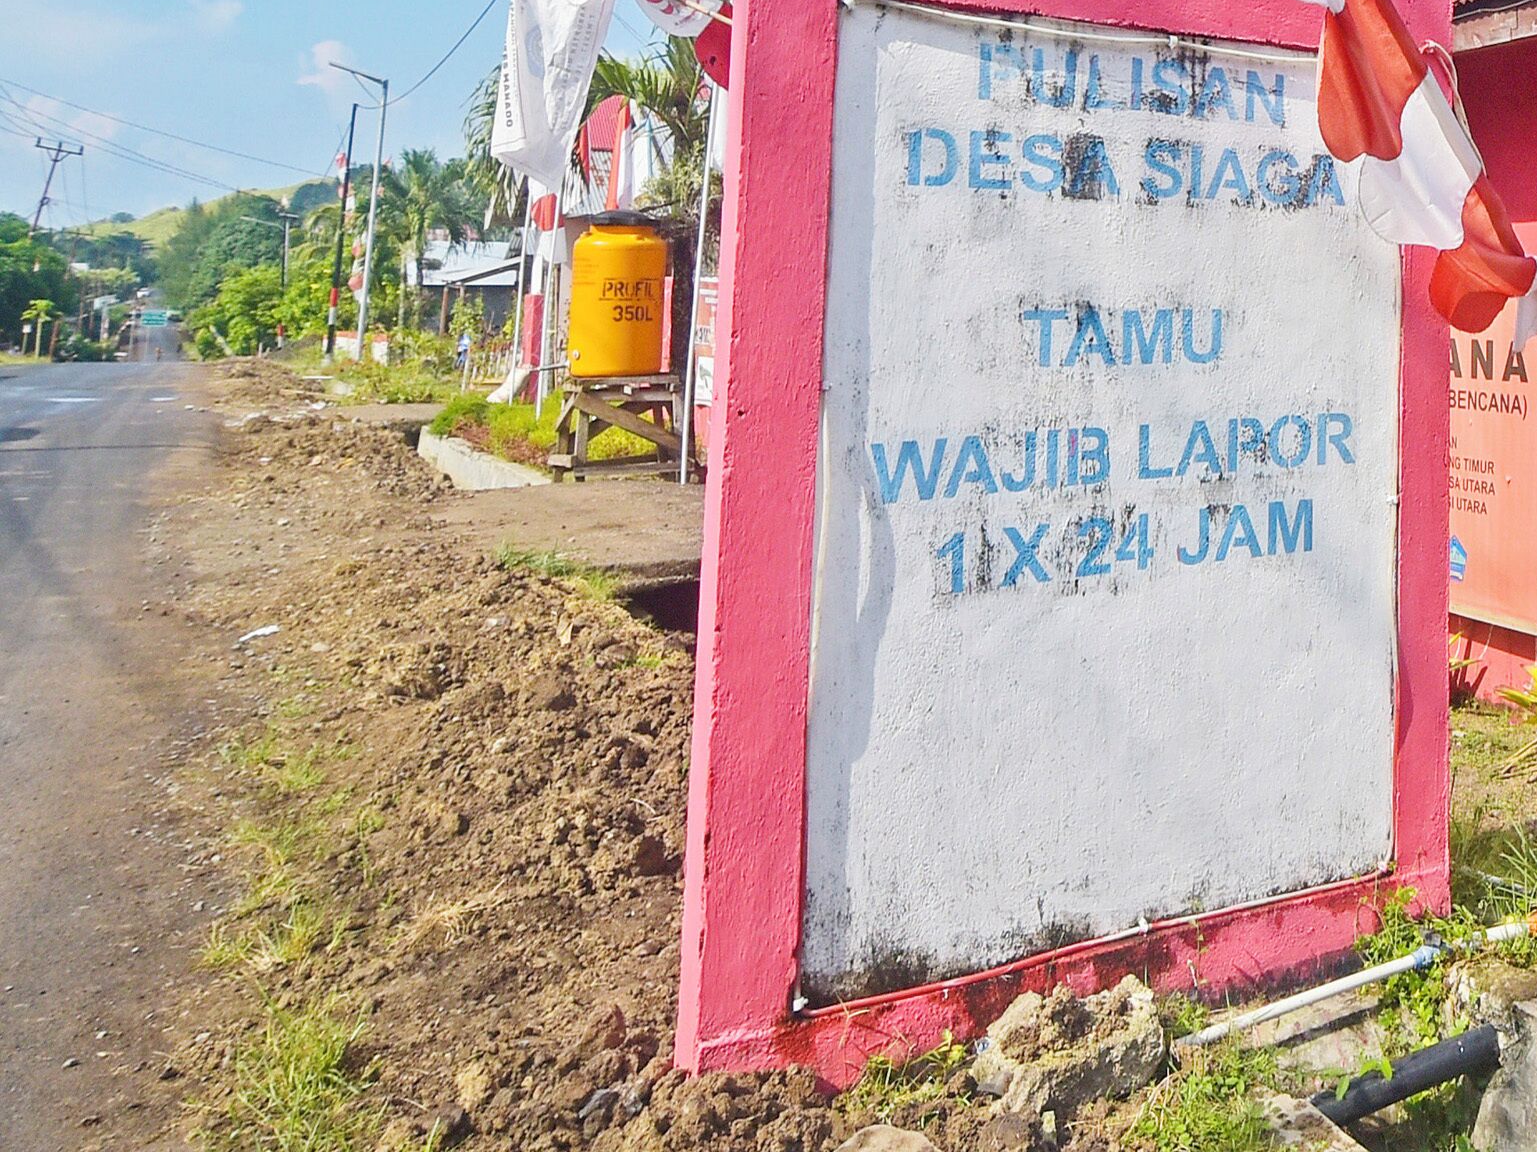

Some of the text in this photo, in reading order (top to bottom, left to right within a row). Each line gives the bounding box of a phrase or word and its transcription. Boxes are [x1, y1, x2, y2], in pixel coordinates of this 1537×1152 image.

[503, 73, 513, 127] MANADO
[977, 42, 1286, 127] PULISAN
[907, 125, 1347, 207] DESA SIAGA
[602, 281, 654, 298] PROFIL
[613, 305, 653, 322] 350L
[1022, 305, 1223, 368] TAMU
[871, 412, 1357, 506] WAJIB LAPOR
[1463, 458, 1495, 475] TIMUR
[1456, 497, 1487, 515] UTARA
[1463, 478, 1496, 496] UTARA
[936, 498, 1315, 594] 1 X 24 JAM
